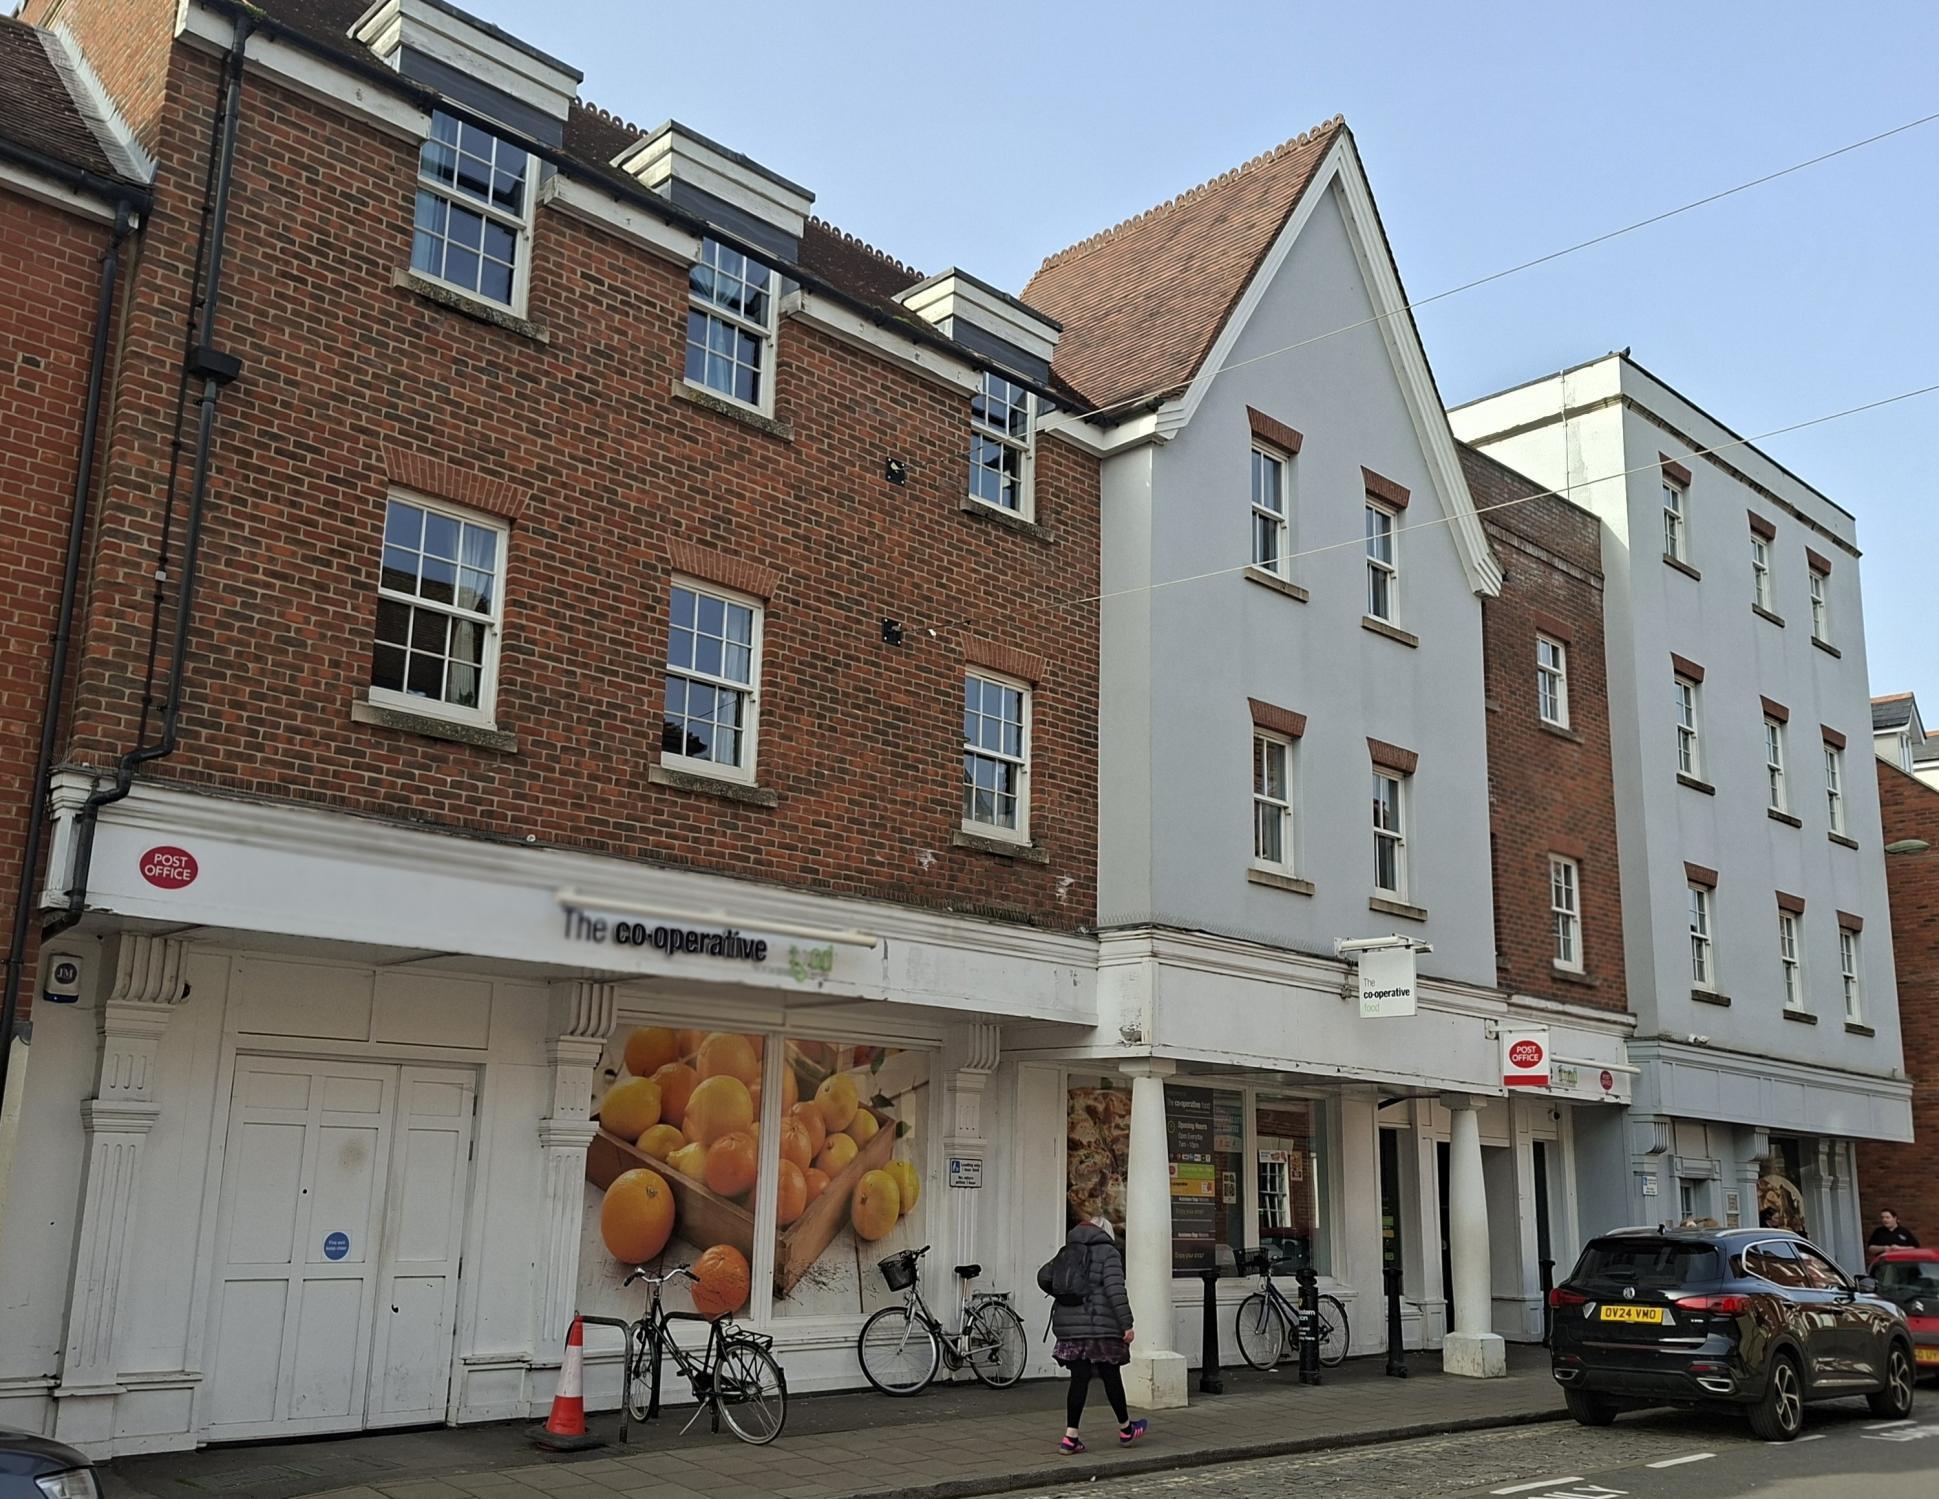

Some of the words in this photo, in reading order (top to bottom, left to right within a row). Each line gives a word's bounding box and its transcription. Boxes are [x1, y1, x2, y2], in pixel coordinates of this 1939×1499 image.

[154, 853, 188, 868] POST
[144, 864, 191, 881] OFFICE
[562, 905, 608, 944] The
[1363, 977, 1376, 988] The
[1363, 986, 1411, 1000] co-operative
[1516, 1045, 1537, 1054] POST
[1511, 1053, 1540, 1062] OFFICE
[1605, 1307, 1633, 1319] OV24
